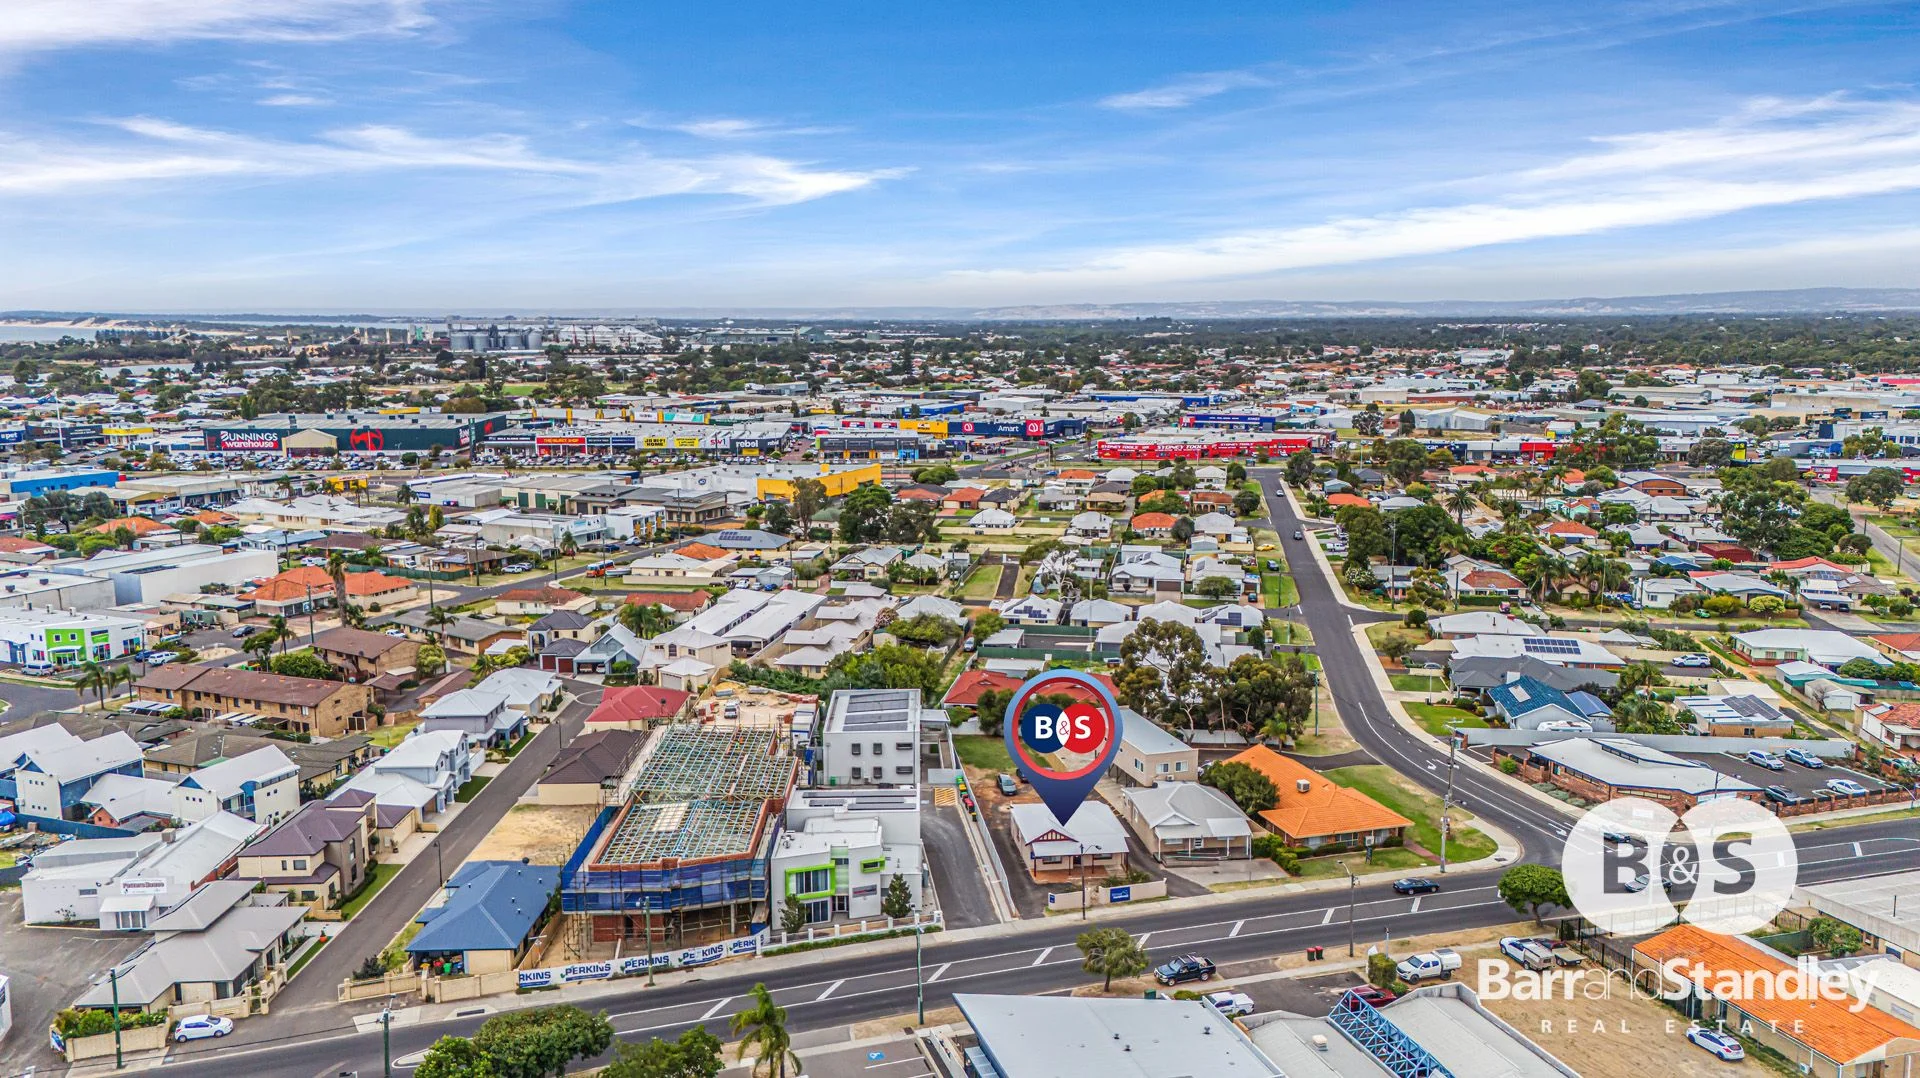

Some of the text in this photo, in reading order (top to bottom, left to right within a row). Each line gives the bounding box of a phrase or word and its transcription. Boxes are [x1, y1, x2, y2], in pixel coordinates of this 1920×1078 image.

[221, 431, 278, 441] BUNNINGS
[225, 440, 274, 449] warehouse
[682, 944, 724, 960] PEKINS
[565, 963, 611, 976] PERKINS
